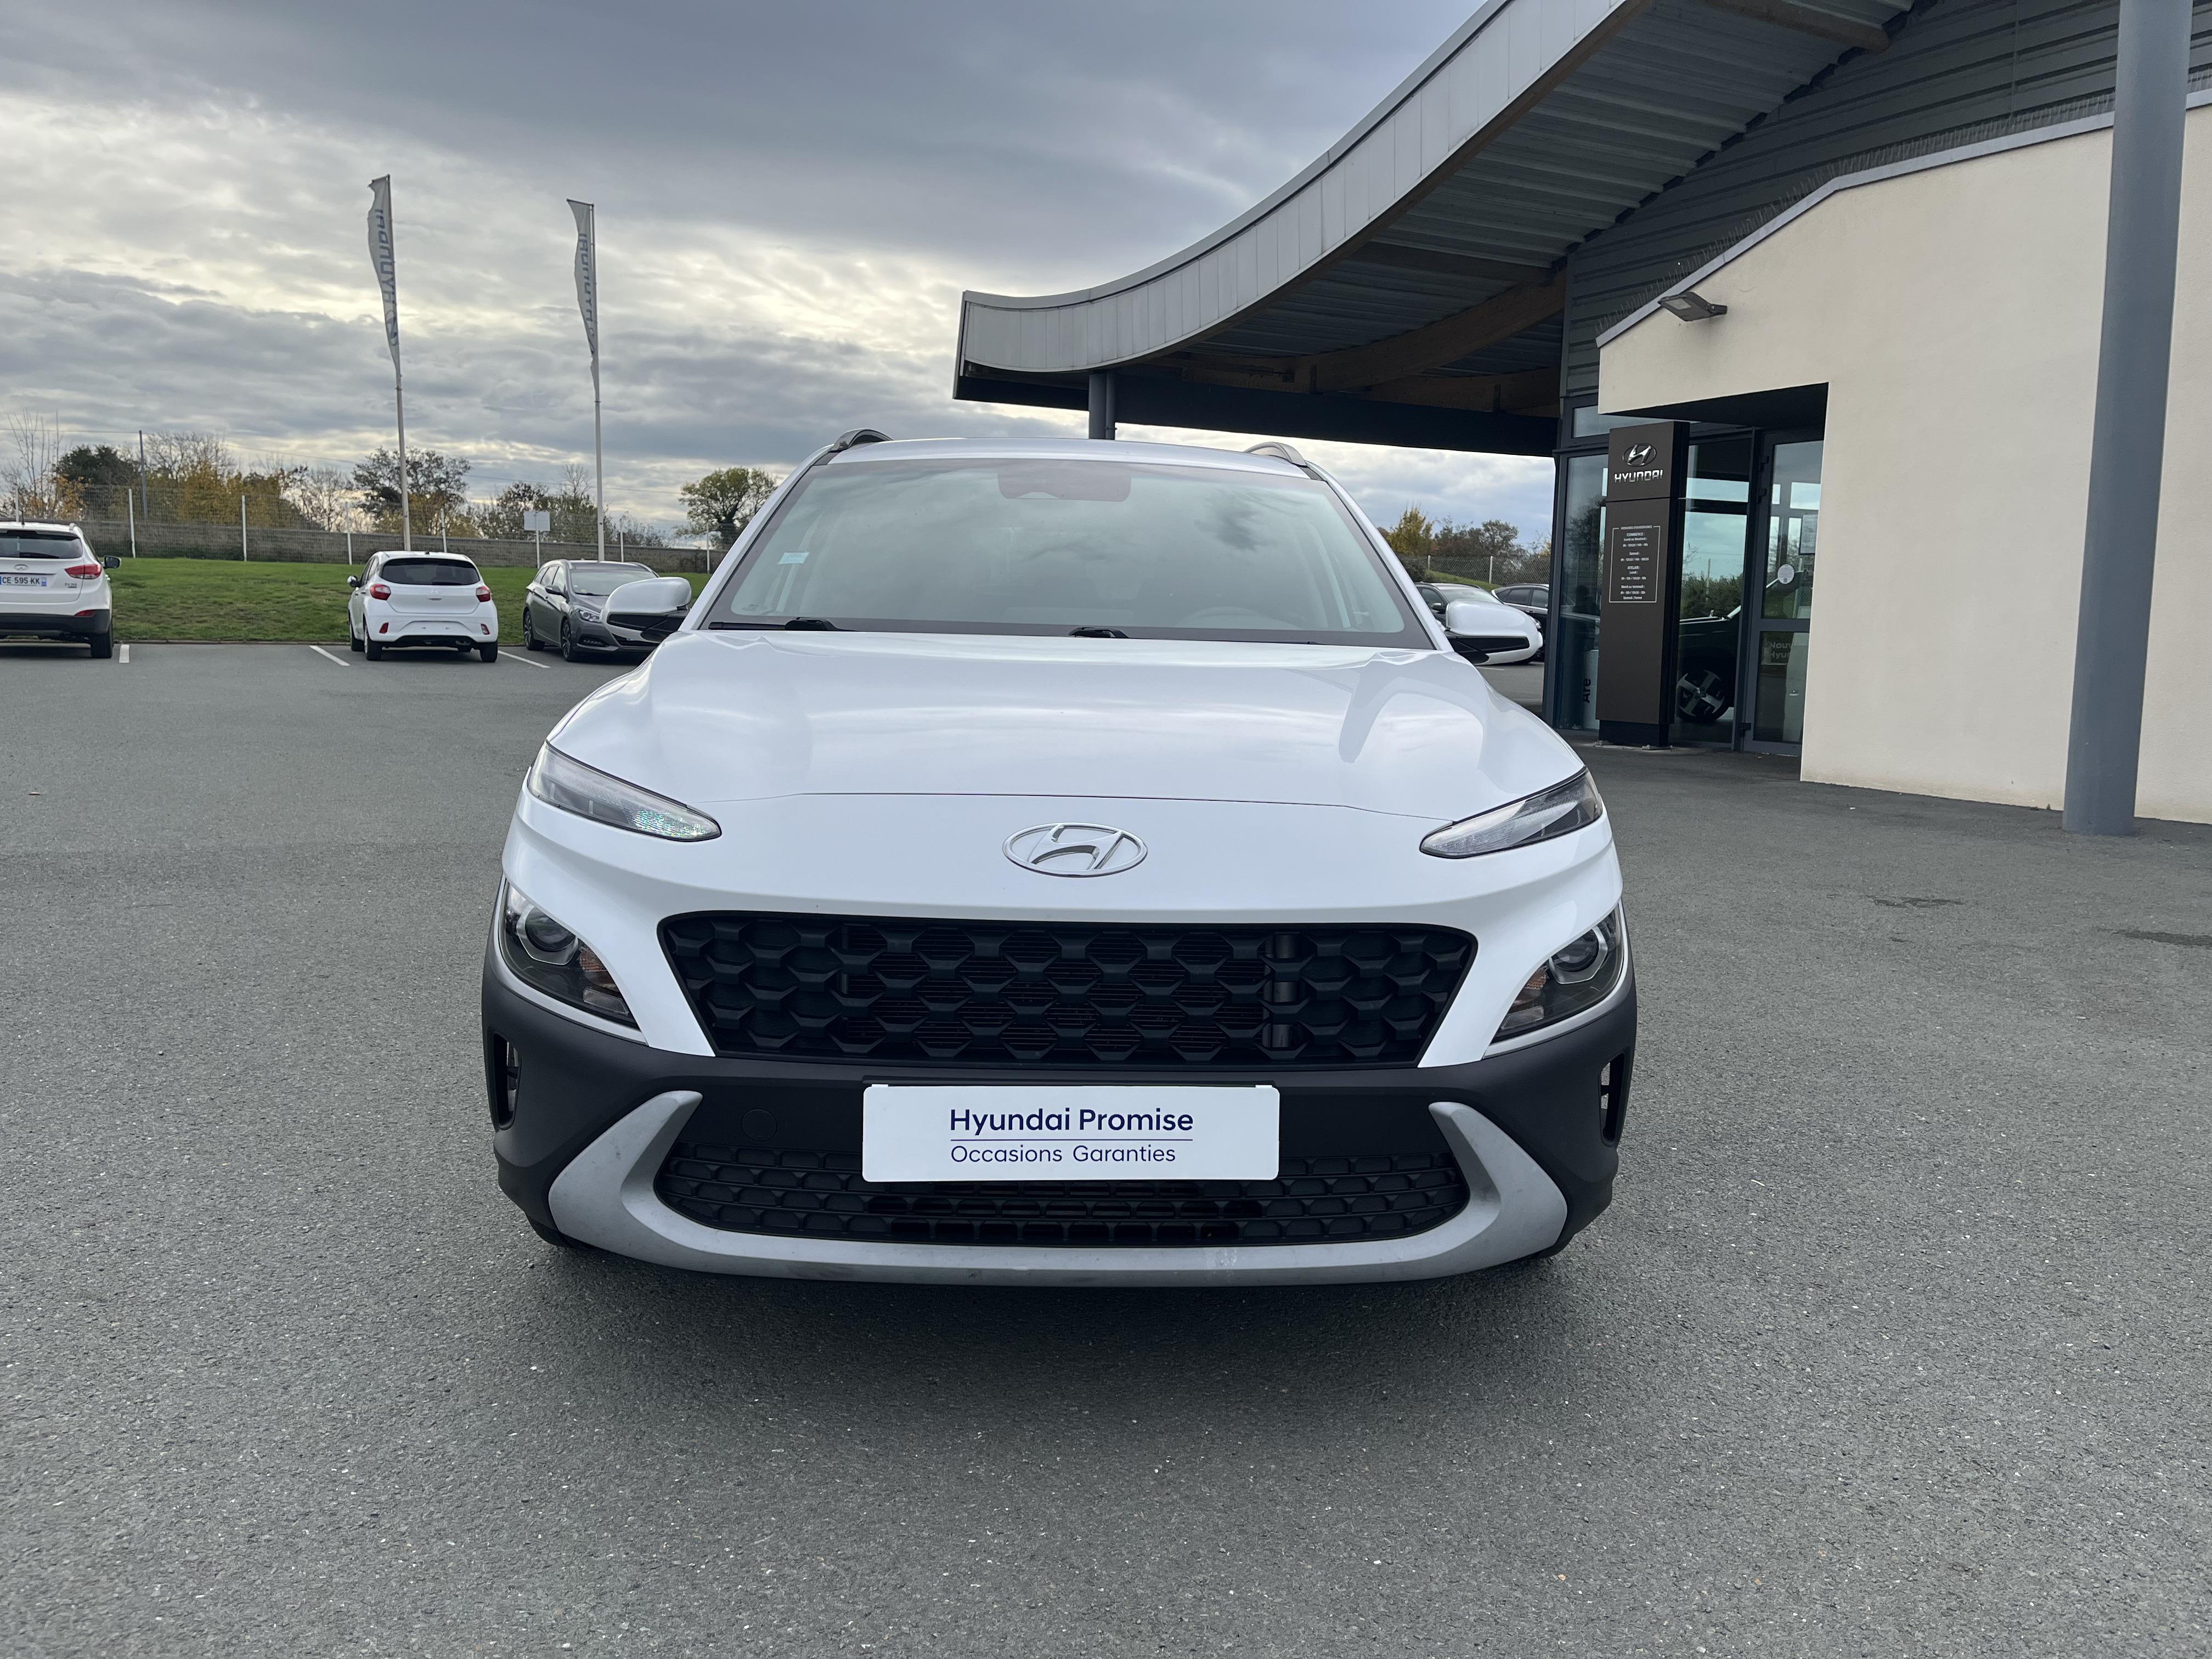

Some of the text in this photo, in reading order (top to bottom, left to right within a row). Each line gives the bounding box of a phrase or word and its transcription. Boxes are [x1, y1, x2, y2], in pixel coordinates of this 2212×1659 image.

[1615, 470, 1663, 483] HYUNDAI
[951, 1107, 1193, 1136] Hyundai Promise
[951, 1144, 1176, 1162] Occasions Garanties
